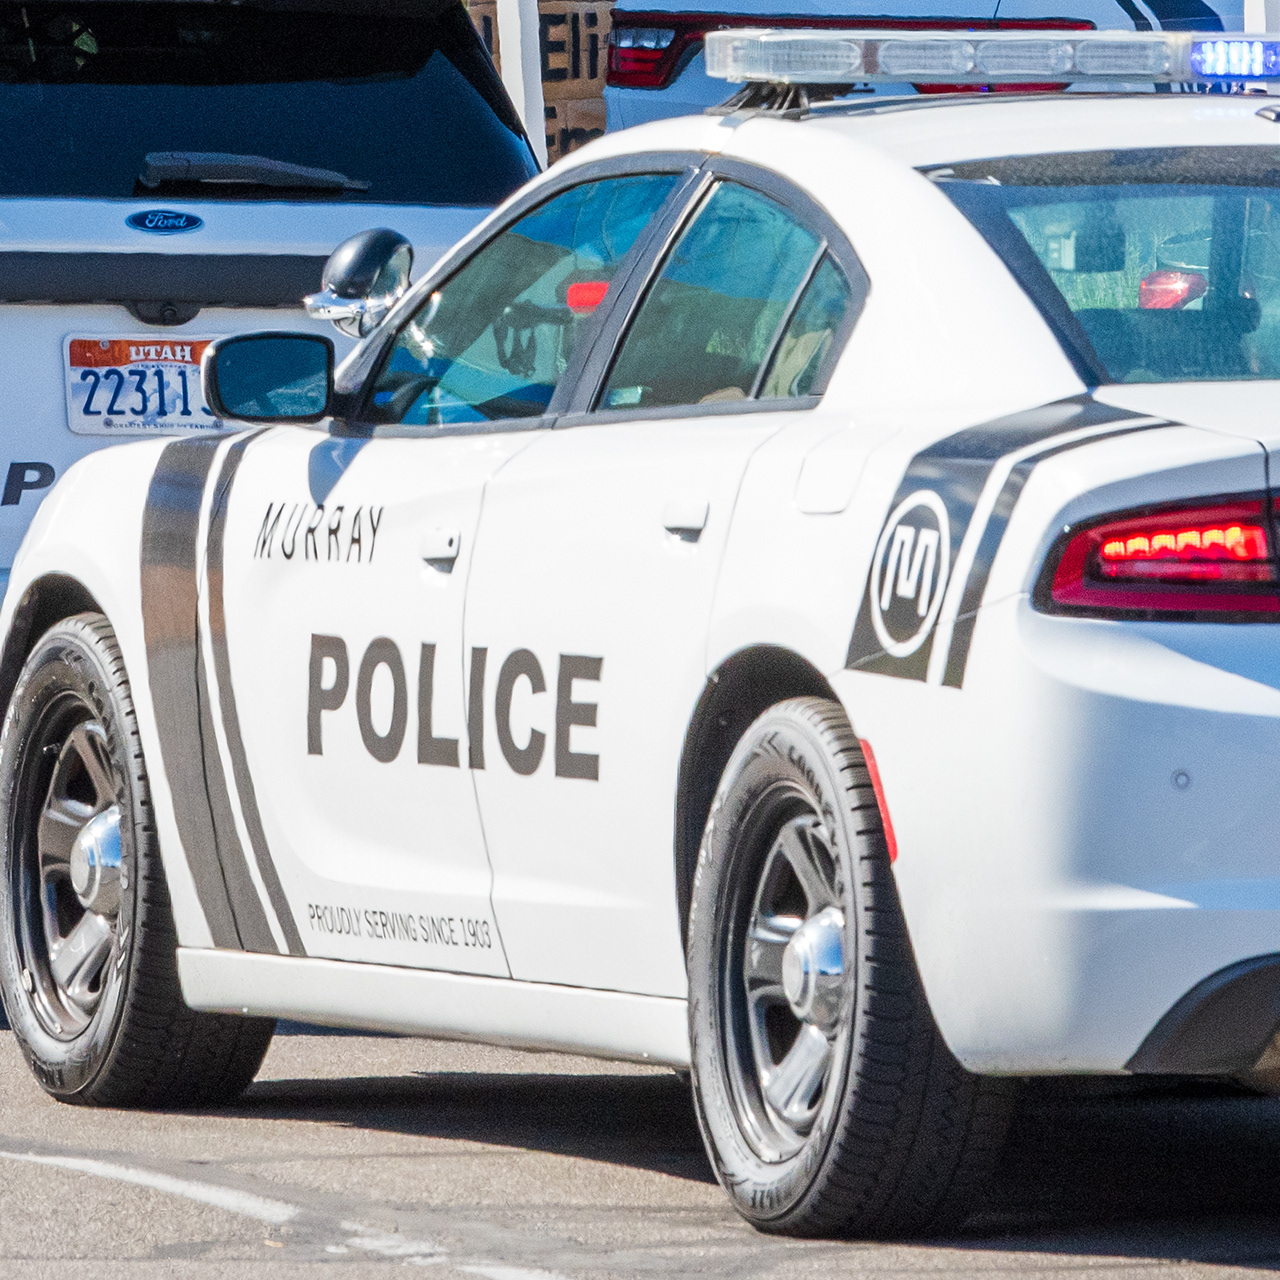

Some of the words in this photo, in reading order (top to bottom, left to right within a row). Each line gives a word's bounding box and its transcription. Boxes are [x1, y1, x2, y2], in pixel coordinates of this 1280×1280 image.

[539, 11, 608, 81] Eli
[145, 212, 188, 228] Ford
[129, 345, 193, 362] UTAH
[80, 368, 214, 417] 22311
[254, 502, 384, 563] MURRAY
[307, 632, 605, 782] POLICE
[308, 903, 362, 936] PROUDLY
[364, 910, 418, 942] SERVING
[419, 915, 459, 946] SINCE
[460, 918, 492, 949] 1903
